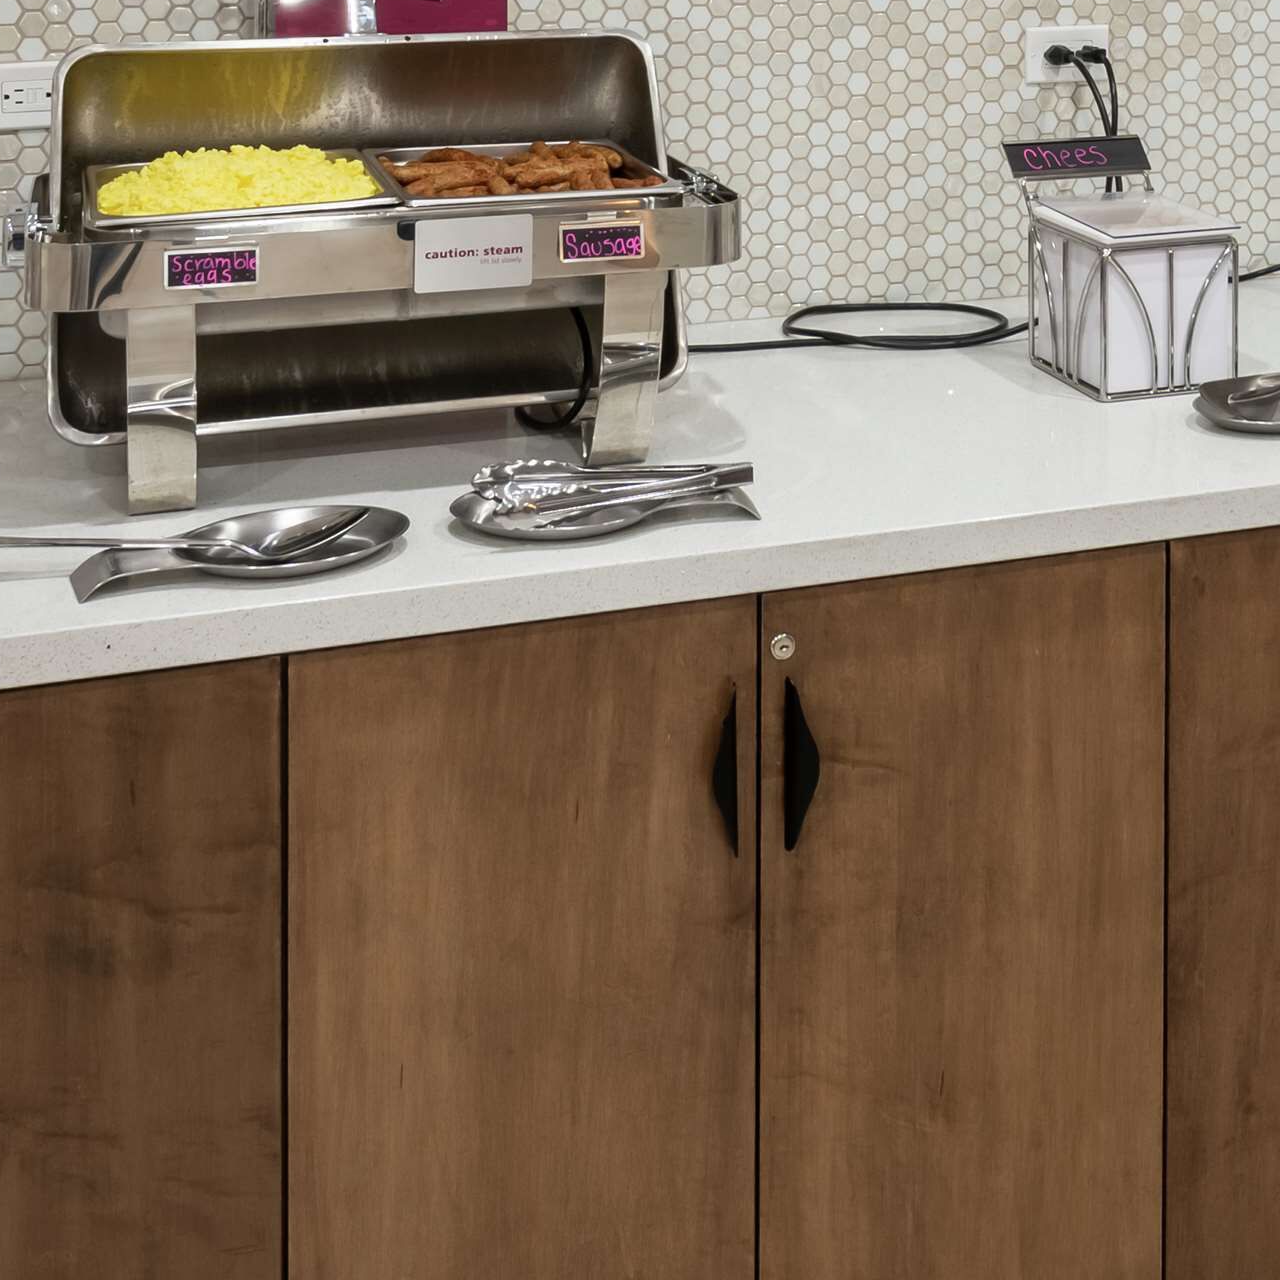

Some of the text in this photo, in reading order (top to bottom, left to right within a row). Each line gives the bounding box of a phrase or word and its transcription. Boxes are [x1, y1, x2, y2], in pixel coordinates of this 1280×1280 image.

[1023, 145, 1108, 170] Chees
[425, 245, 523, 260] caution: steam
[565, 233, 641, 259] Sausage
[172, 249, 256, 272] Scramble
